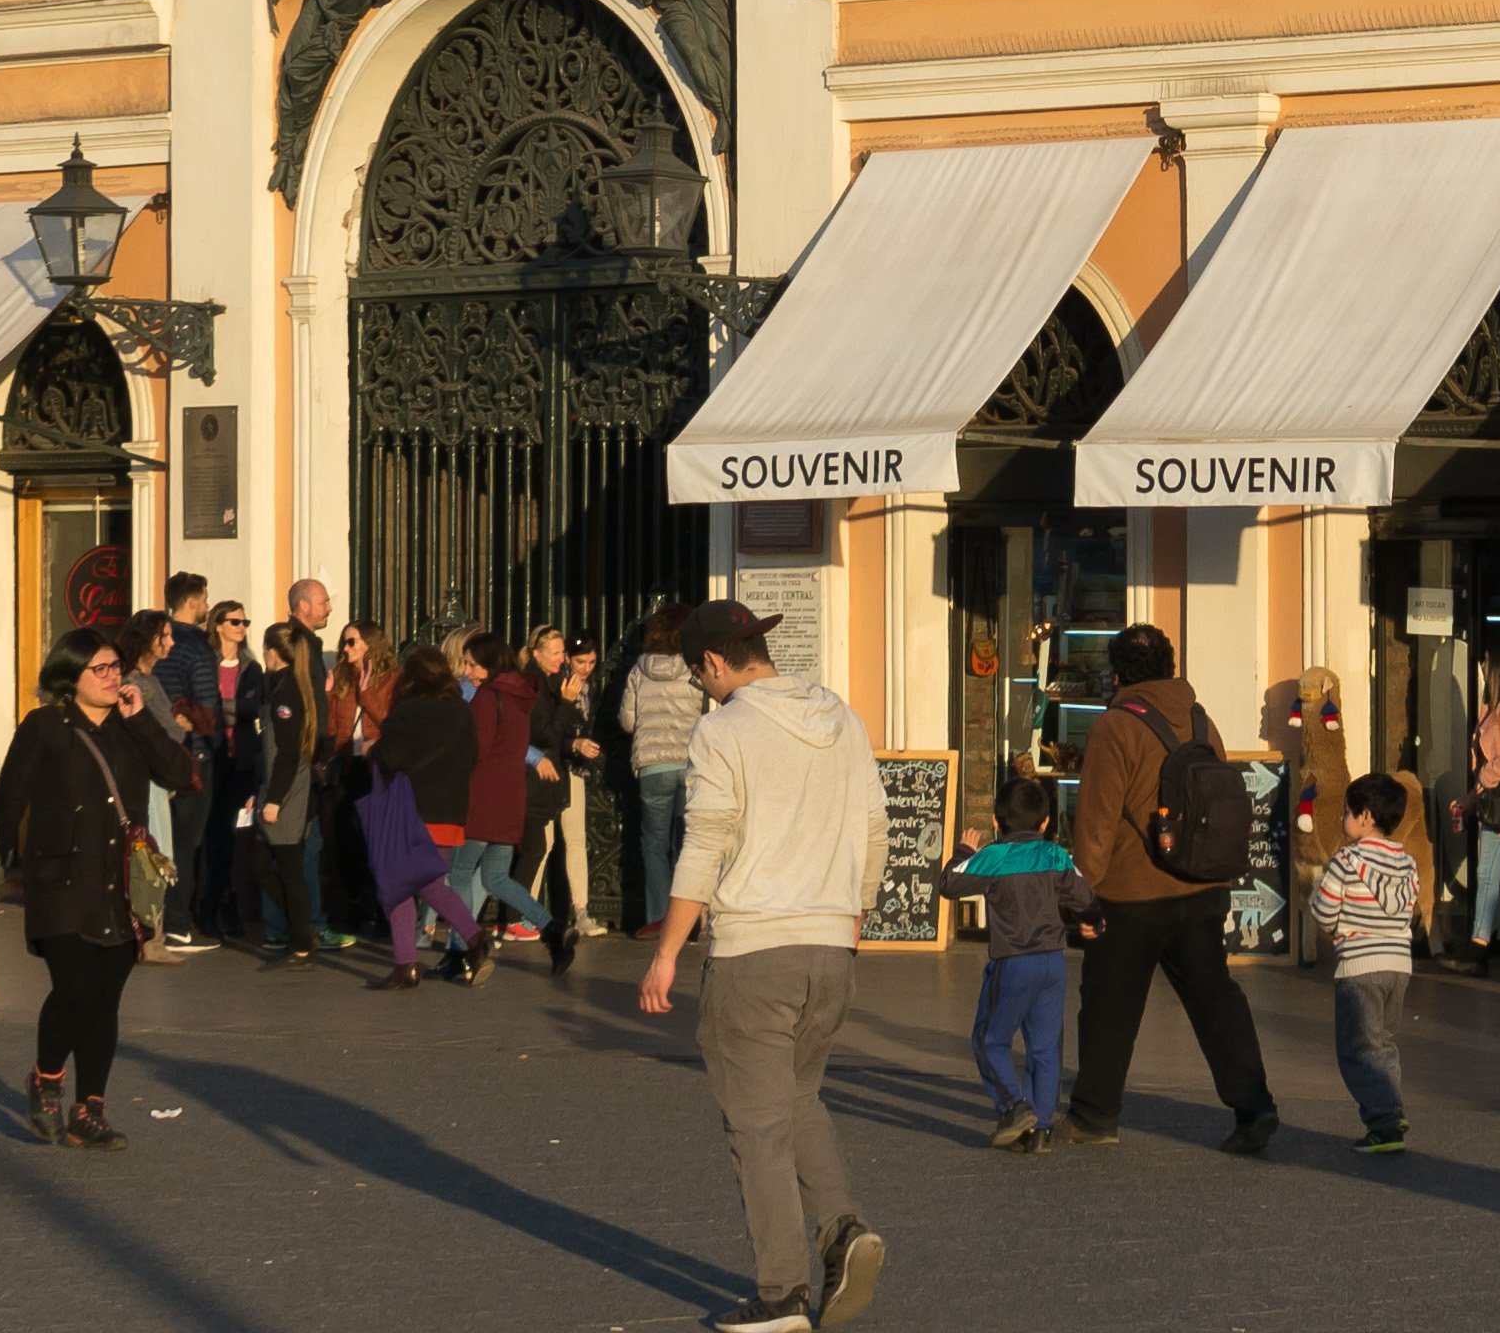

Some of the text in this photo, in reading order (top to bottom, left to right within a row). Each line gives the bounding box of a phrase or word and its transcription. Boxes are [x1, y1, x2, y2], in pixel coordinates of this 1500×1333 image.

[721, 449, 903, 490] SOUVENIR
[1135, 457, 1337, 493] SOUVENIR
[746, 590, 814, 601] MERCADO CENTRAL
